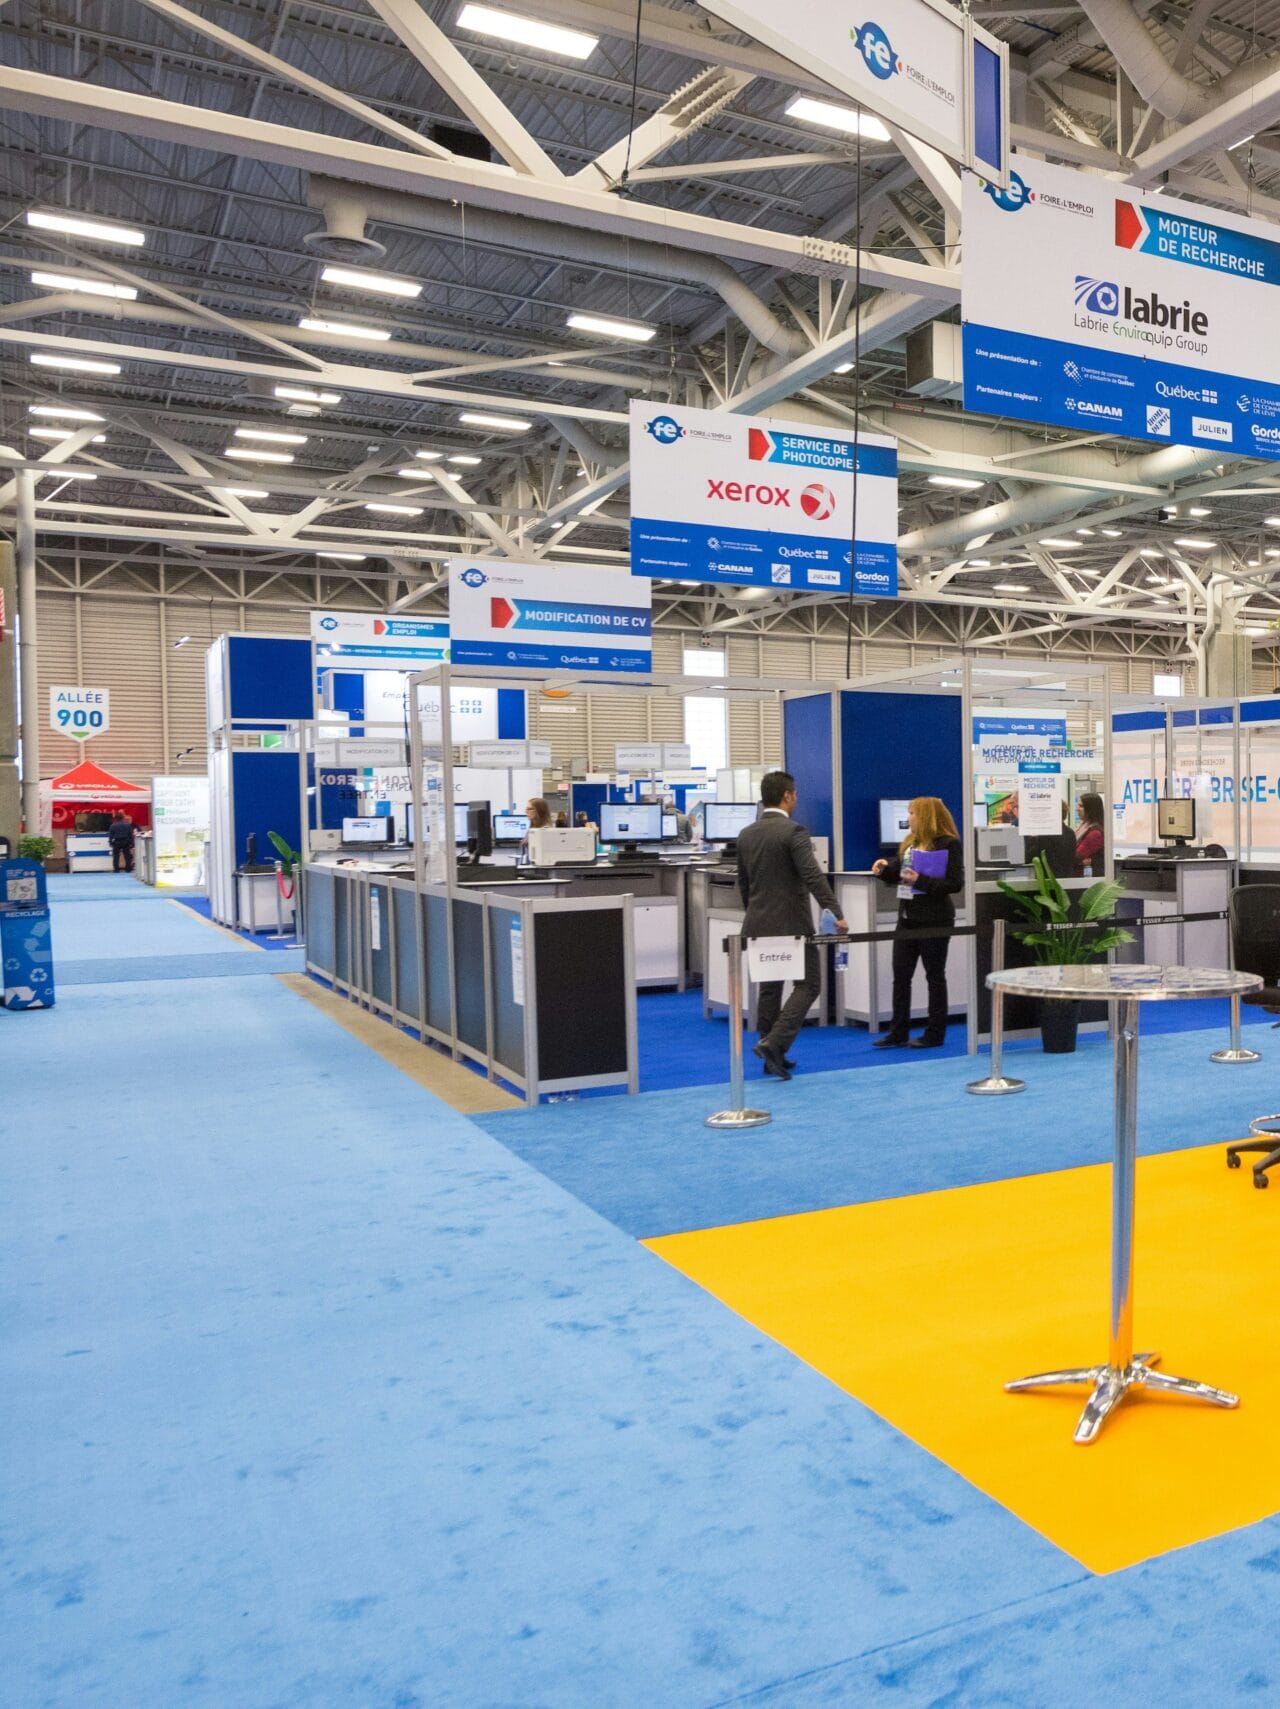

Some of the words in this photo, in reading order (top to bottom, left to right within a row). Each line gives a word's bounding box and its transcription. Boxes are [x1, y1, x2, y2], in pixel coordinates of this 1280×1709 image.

[906, 65, 925, 84] FOIRE
[1040, 193, 1061, 206] FOIRE
[1063, 199, 1094, 214] L'EMPLOI
[1158, 217, 1218, 246] MOTEUR
[1158, 238, 1177, 255] DE
[1181, 243, 1265, 277] RECHERCHE
[1124, 286, 1209, 336] labrie
[1074, 313, 1109, 333] Labrie
[1176, 335, 1208, 355] Group
[976, 348, 989, 358] Une
[989, 351, 1029, 365] présentation
[976, 385, 1013, 398] Partenaires
[1013, 391, 1039, 402] majeurs
[1155, 381, 1201, 402] Québec
[1077, 401, 1123, 417] CANAM
[1146, 407, 1165, 427] HOME
[654, 421, 677, 437] fe
[1197, 424, 1228, 435] JULIEN
[782, 437, 830, 453] SERVICE
[833, 443, 848, 455] DE
[782, 450, 860, 470] PHOTOCOPIES
[707, 479, 791, 508] xerox
[778, 546, 816, 559] Québec
[717, 563, 754, 573] CANAM
[855, 571, 890, 582] Gordon
[465, 571, 482, 583] fe
[392, 622, 435, 631] ORGANISMES
[525, 610, 610, 625] MODIFICATION
[613, 615, 628, 626] DE
[631, 617, 647, 628] CV
[560, 655, 589, 664] Québec
[57, 691, 103, 704] ALLÉE
[56, 709, 103, 727] 900
[982, 749, 1021, 758] MOTEUR
[1040, 749, 1094, 758] RECHERCHE
[759, 951, 792, 963] Entrée
